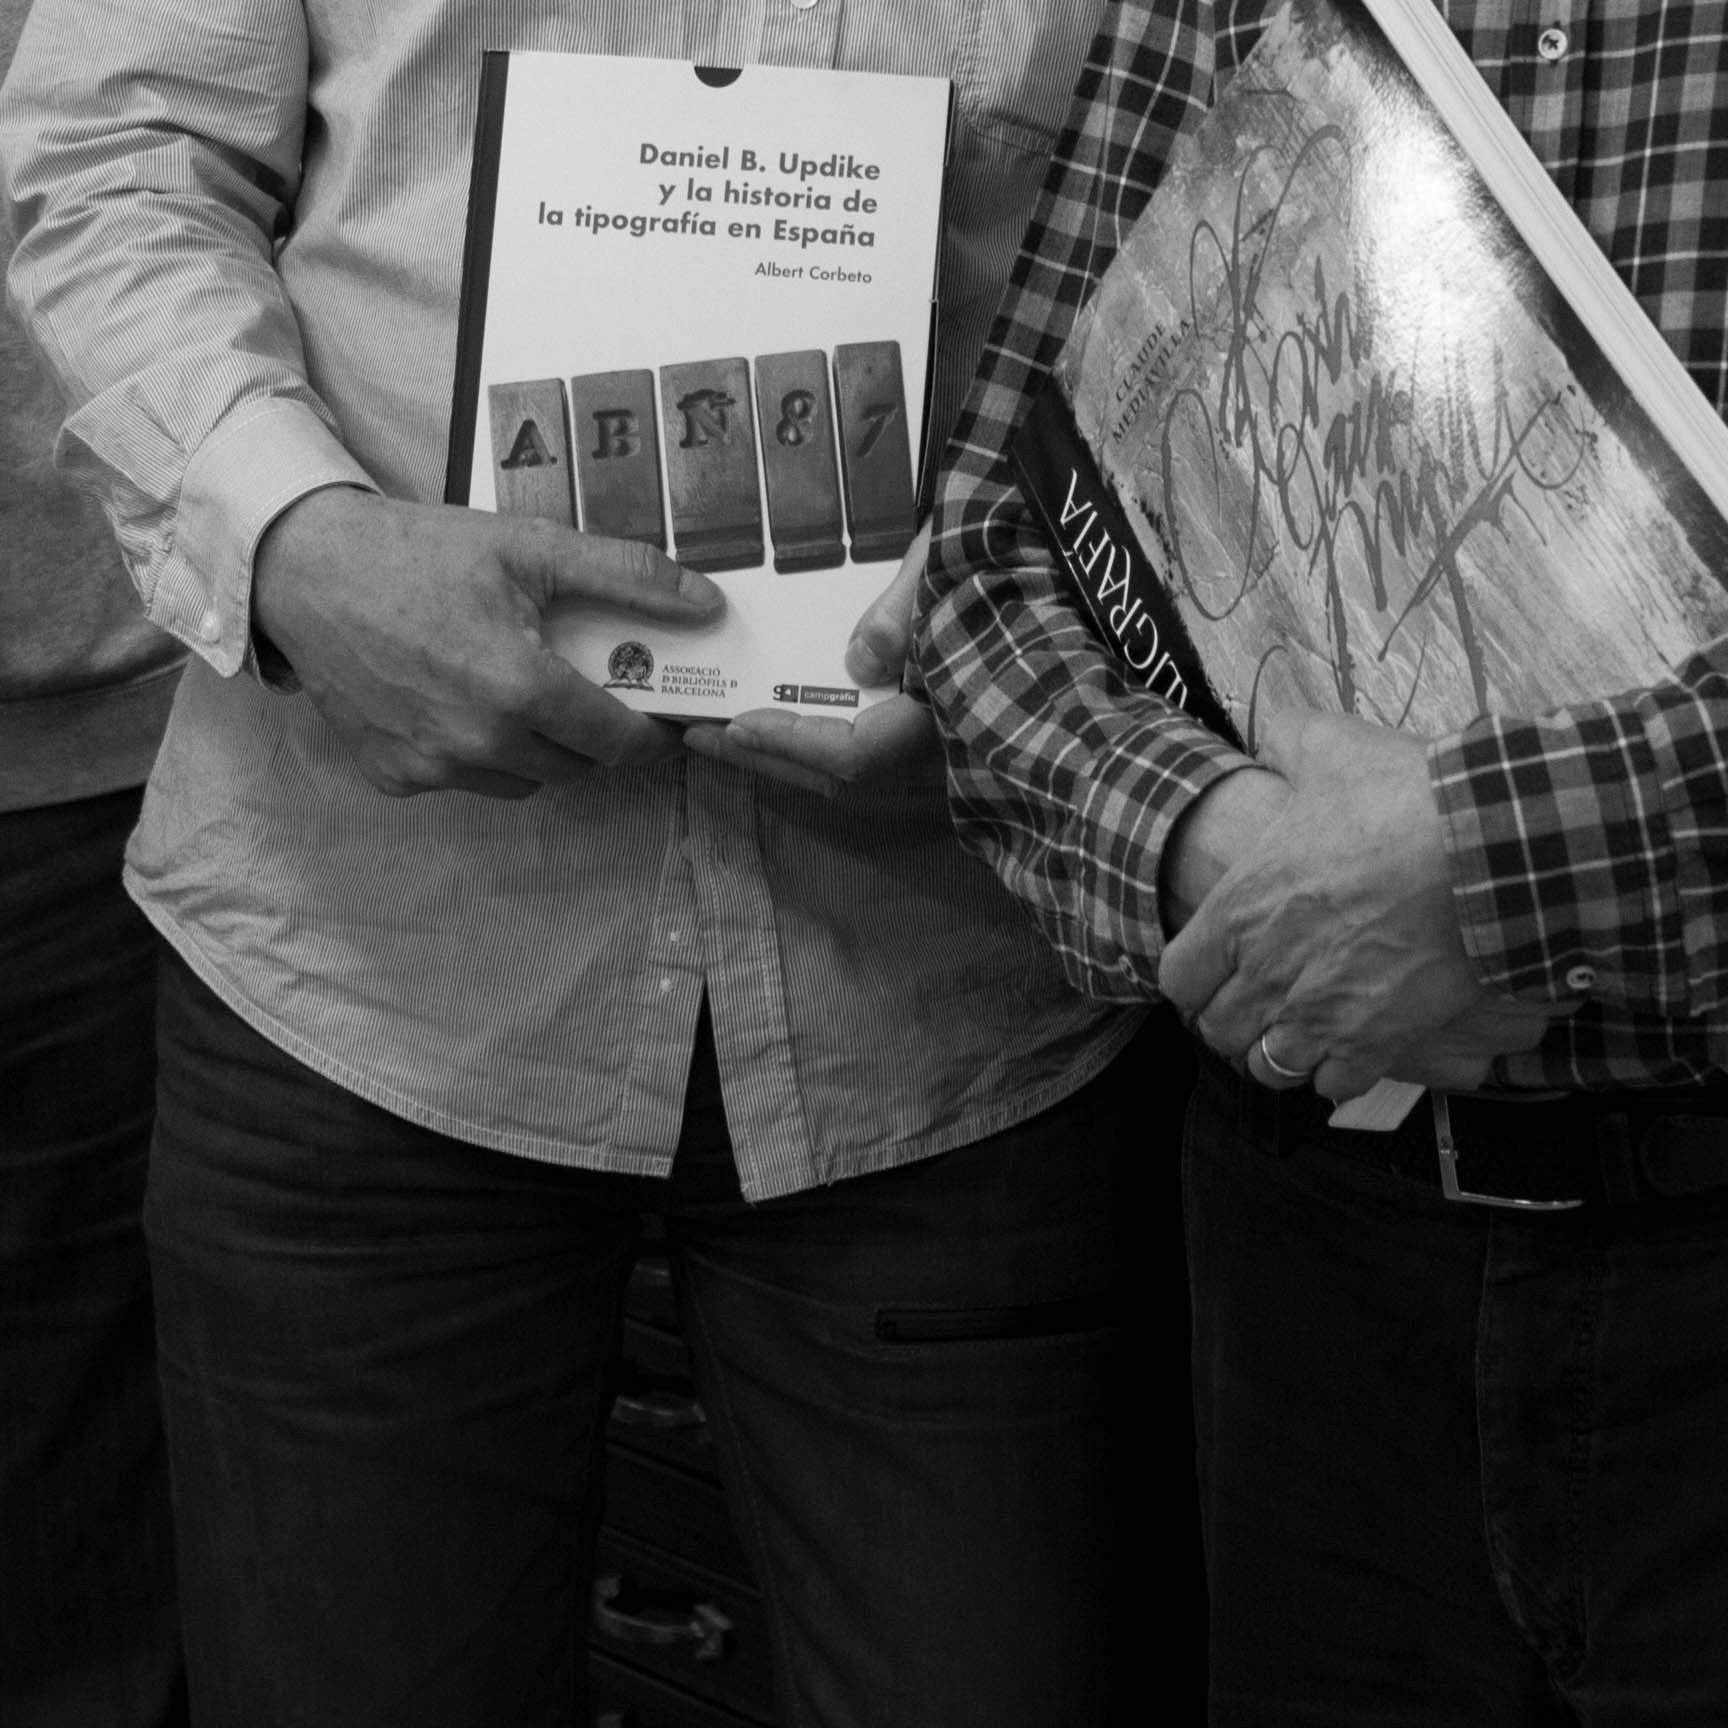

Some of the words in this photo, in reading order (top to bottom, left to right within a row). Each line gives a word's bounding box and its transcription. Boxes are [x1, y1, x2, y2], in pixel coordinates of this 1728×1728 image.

[639, 142, 729, 170] Daniel
[740, 148, 766, 172] B.
[778, 151, 881, 182] Updike
[658, 182, 677, 206] y
[686, 176, 713, 203] la
[723, 179, 832, 211] historia
[842, 189, 878, 214] de
[537, 200, 564, 227] la
[574, 204, 717, 238] tipografía
[727, 221, 762, 239] en
[773, 219, 876, 250] España
[754, 261, 804, 280] Albert
[809, 265, 873, 285] Corbeto
[1112, 319, 1191, 445] MEDIAVILLA
[1115, 323, 1165, 403] CLAUDE
